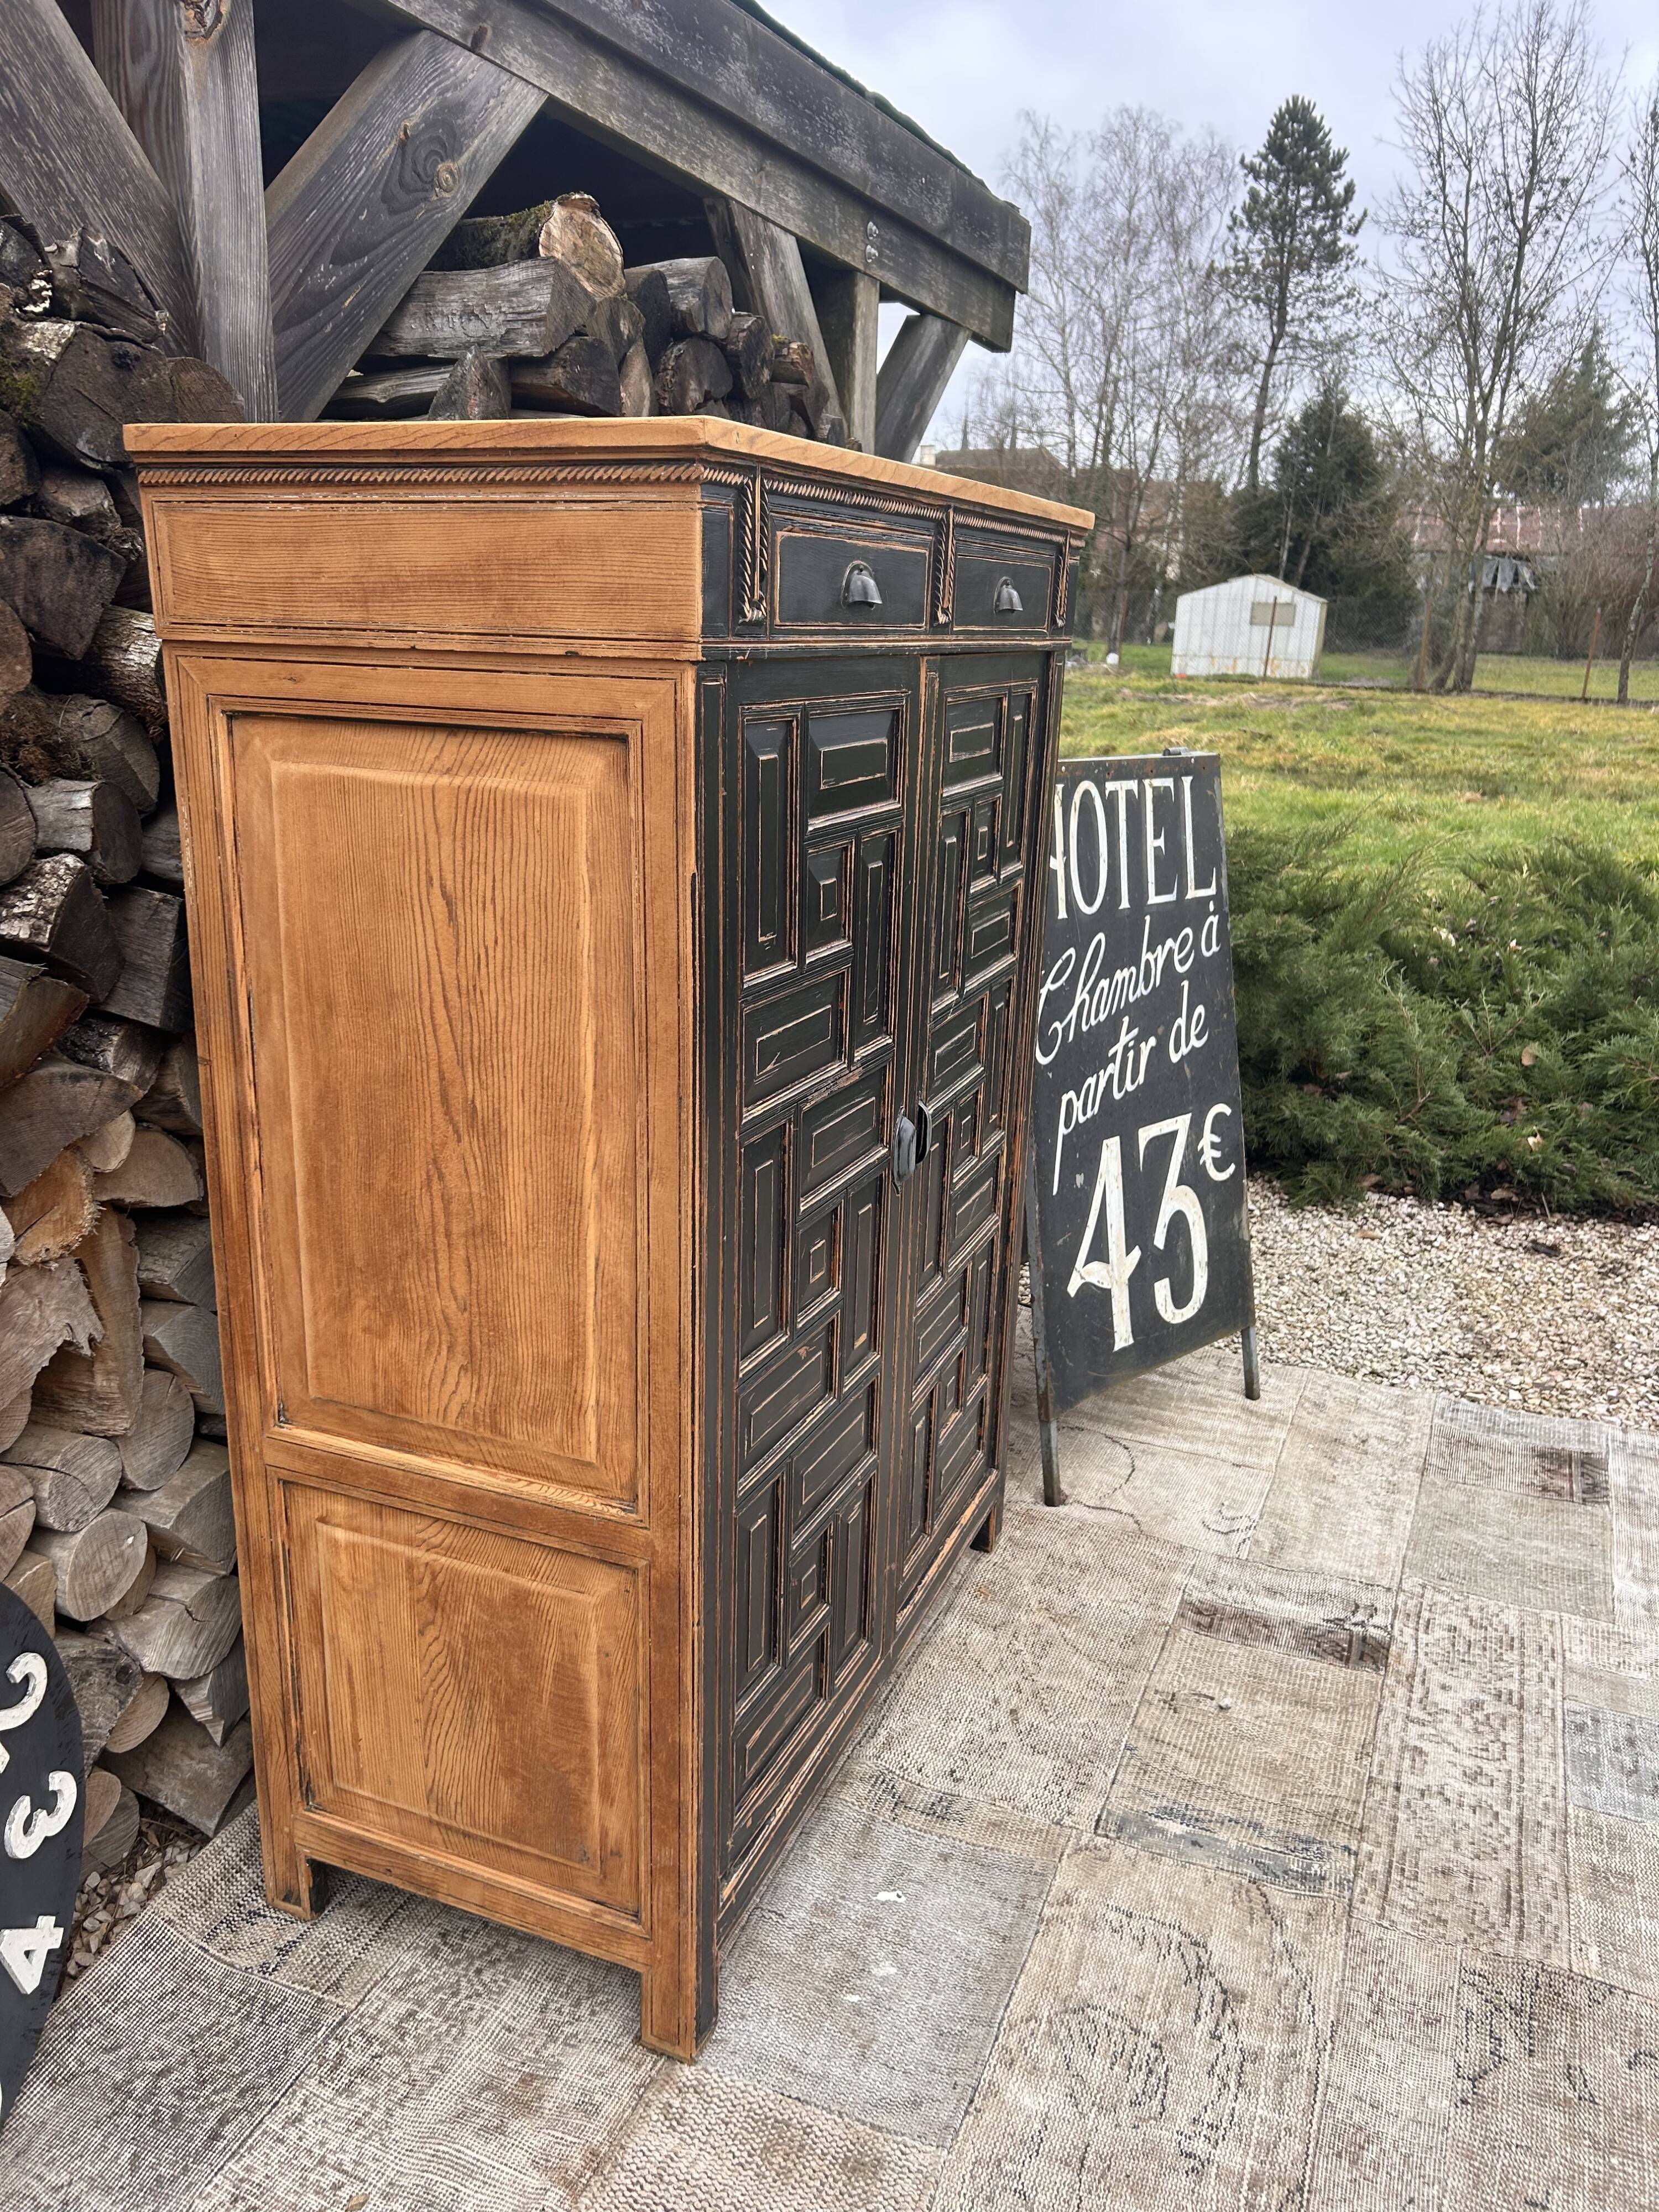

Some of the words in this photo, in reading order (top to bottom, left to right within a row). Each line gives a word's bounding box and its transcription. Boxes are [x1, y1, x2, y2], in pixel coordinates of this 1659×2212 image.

[1035, 915, 1195, 1065] Chambre
[1052, 1016, 1157, 1196] partir
[1169, 980, 1209, 1063] de
[4, 1771, 77, 1859] 3
[0, 1915, 64, 1995] 4
